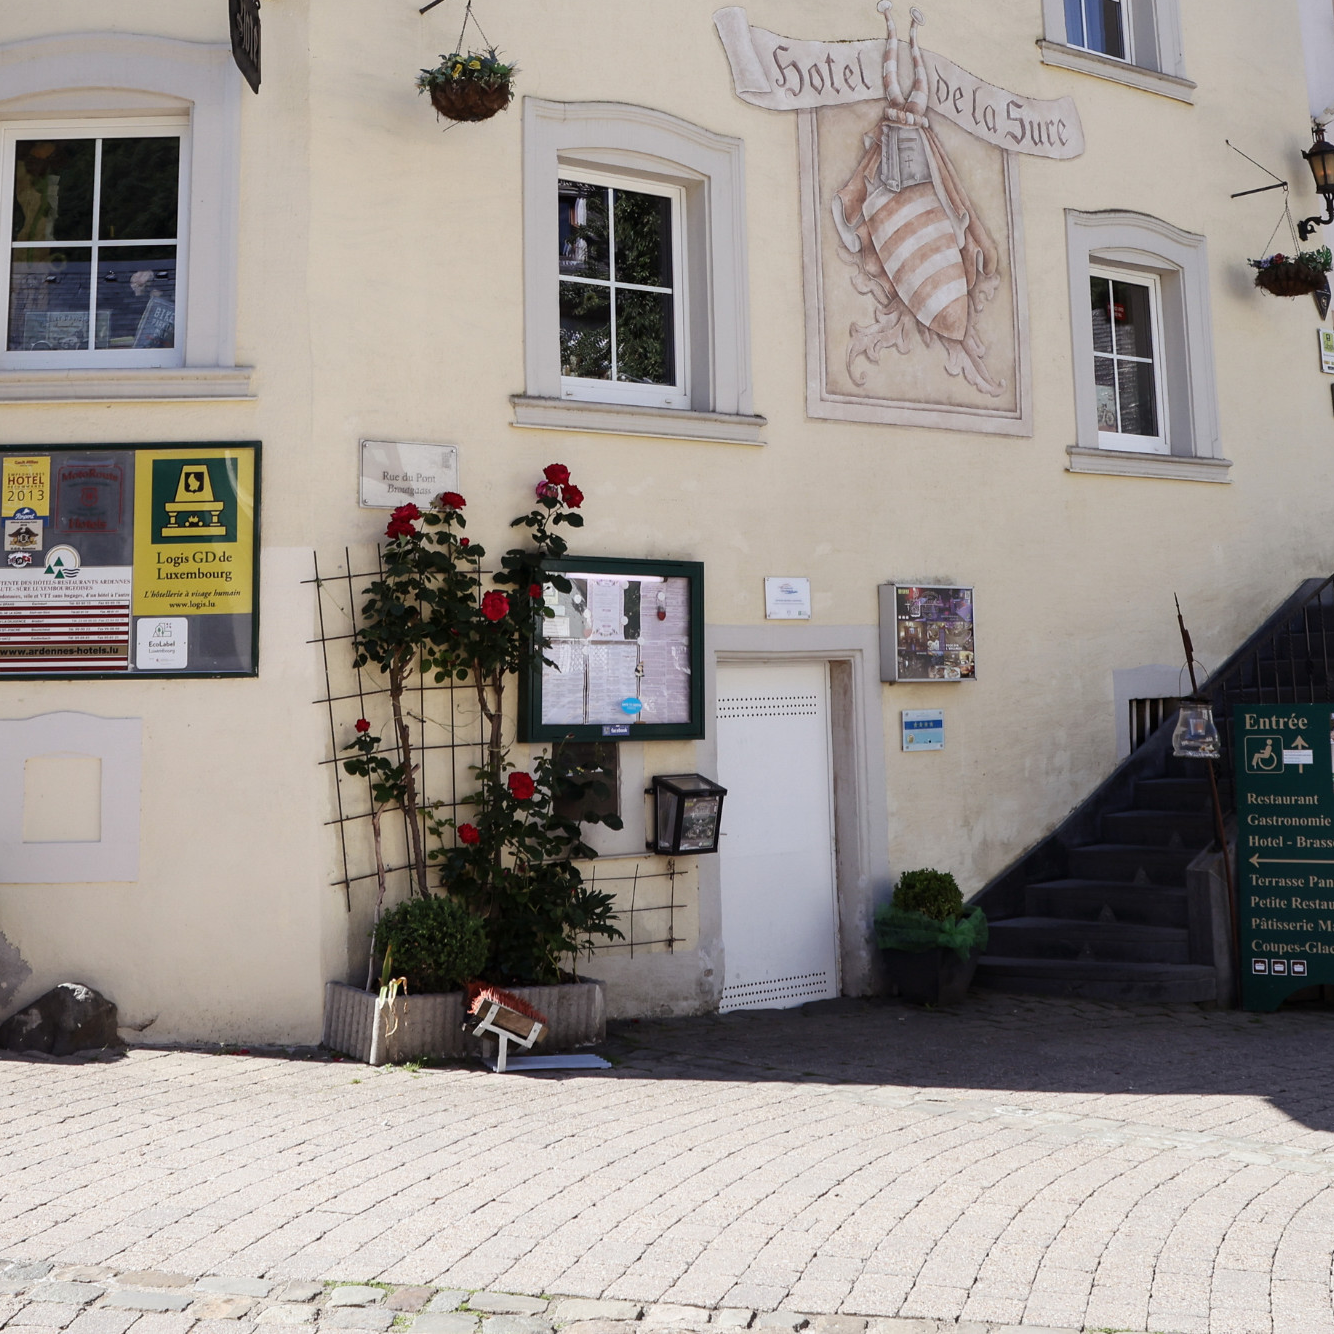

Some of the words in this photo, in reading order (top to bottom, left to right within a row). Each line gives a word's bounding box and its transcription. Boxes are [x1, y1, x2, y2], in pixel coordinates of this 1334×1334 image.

[772, 45, 875, 97] Hotel
[934, 64, 966, 115] de
[971, 85, 999, 134] la
[8, 476, 44, 485] HOTEL
[62, 469, 118, 482] MotoRoute
[383, 471, 400, 481] Rue
[402, 472, 413, 482] du
[416, 473, 436, 483] Pont
[8, 490, 44, 501] 2013
[68, 518, 107, 529] Hotels
[157, 552, 189, 567] Logis
[193, 551, 216, 563] GD
[218, 551, 232, 562] de
[157, 567, 232, 582] Luxembourg
[144, 590, 182, 598] L'hôtellerie
[192, 590, 212, 599] visage
[213, 589, 241, 597] humain
[169, 600, 216, 609] www.logis.lu
[0, 646, 118, 656] www.ardennes-hotels.lu
[1244, 713, 1308, 731] Entrée
[1247, 792, 1319, 806] Restaurant
[1247, 814, 1332, 827] Gastronomie
[1248, 836, 1284, 848] Hotel
[1249, 874, 1305, 888] Terrasse
[1250, 896, 1288, 909] Petite
[1251, 917, 1314, 932] Pâtisserie
